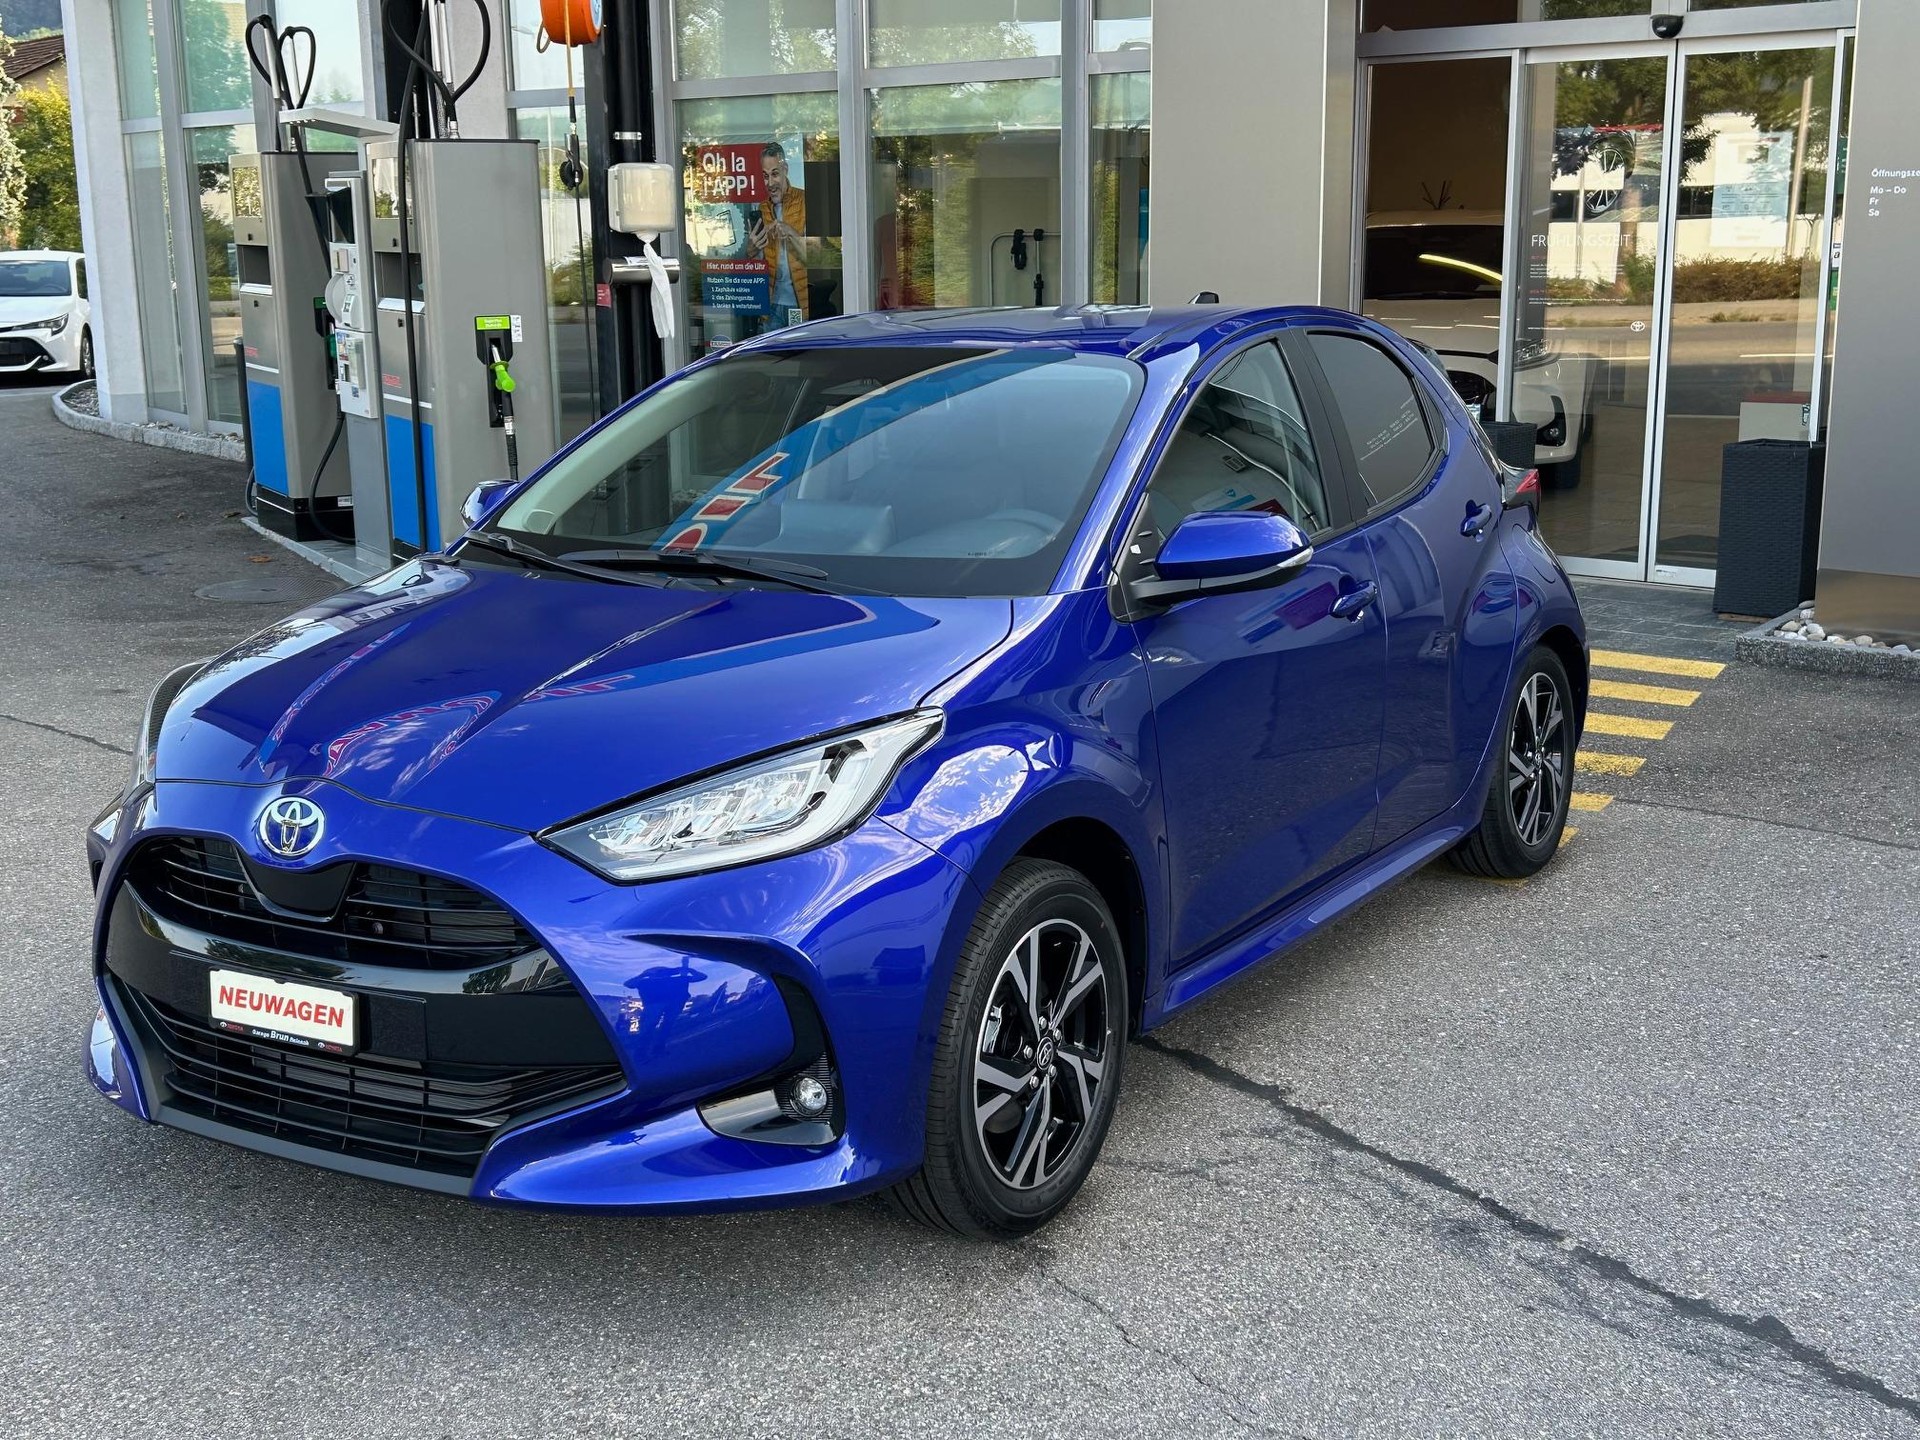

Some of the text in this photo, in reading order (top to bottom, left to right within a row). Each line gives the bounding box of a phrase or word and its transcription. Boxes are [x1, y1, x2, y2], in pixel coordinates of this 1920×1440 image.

[702, 151, 747, 173] Oh la
[1870, 186, 1884, 194] Mo
[1893, 186, 1907, 194] Do
[1869, 197, 1880, 205] Fr
[1868, 208, 1880, 217] Sa
[720, 262, 734, 270] rund
[745, 262, 754, 270] die
[755, 262, 767, 270] Uhr
[219, 985, 345, 1028] NEUWAGEN
[270, 1030, 290, 1042] Brun
